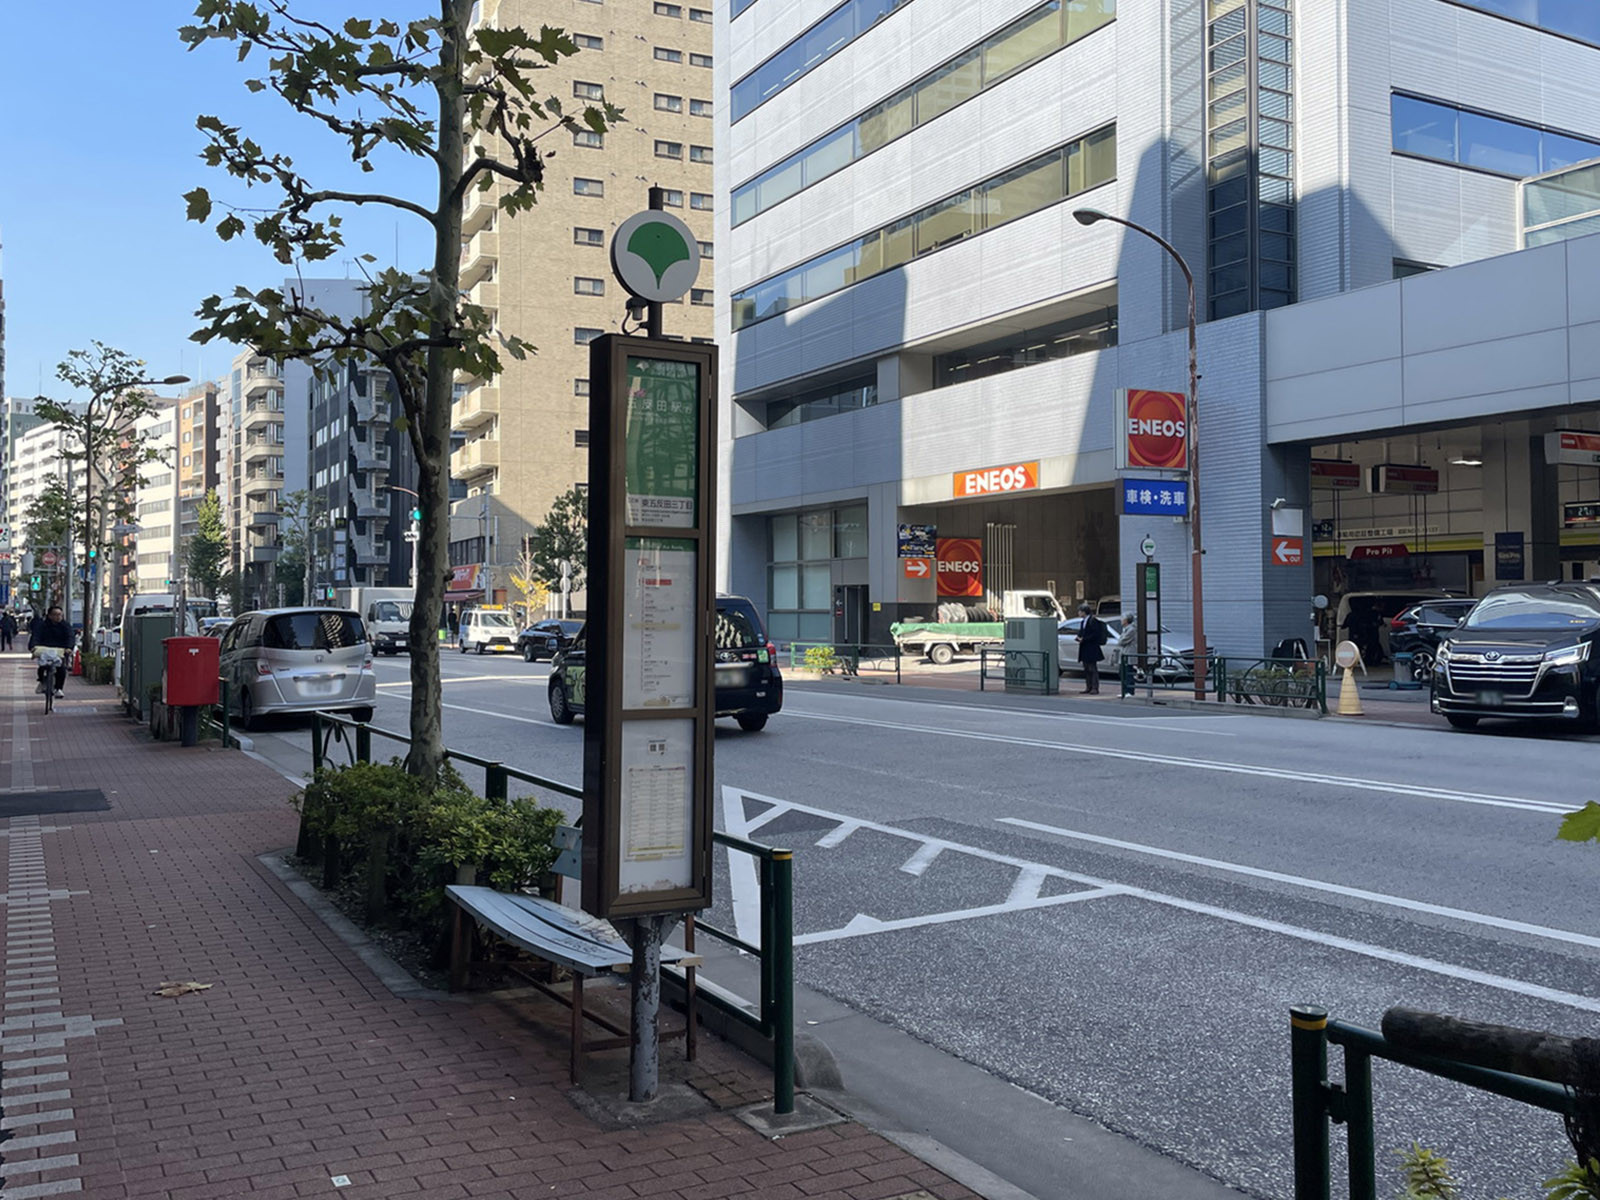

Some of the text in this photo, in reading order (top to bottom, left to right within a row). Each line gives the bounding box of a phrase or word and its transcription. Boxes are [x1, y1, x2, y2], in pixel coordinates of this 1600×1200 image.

[1128, 418, 1185, 437] ENEOS
[965, 465, 1026, 494] ENEOS
[642, 499, 693, 510] 東五反田三丁目
[1126, 489, 1185, 506] 車検・洗車
[1382, 547, 1393, 555] Pit
[937, 561, 980, 573] ENEOS
